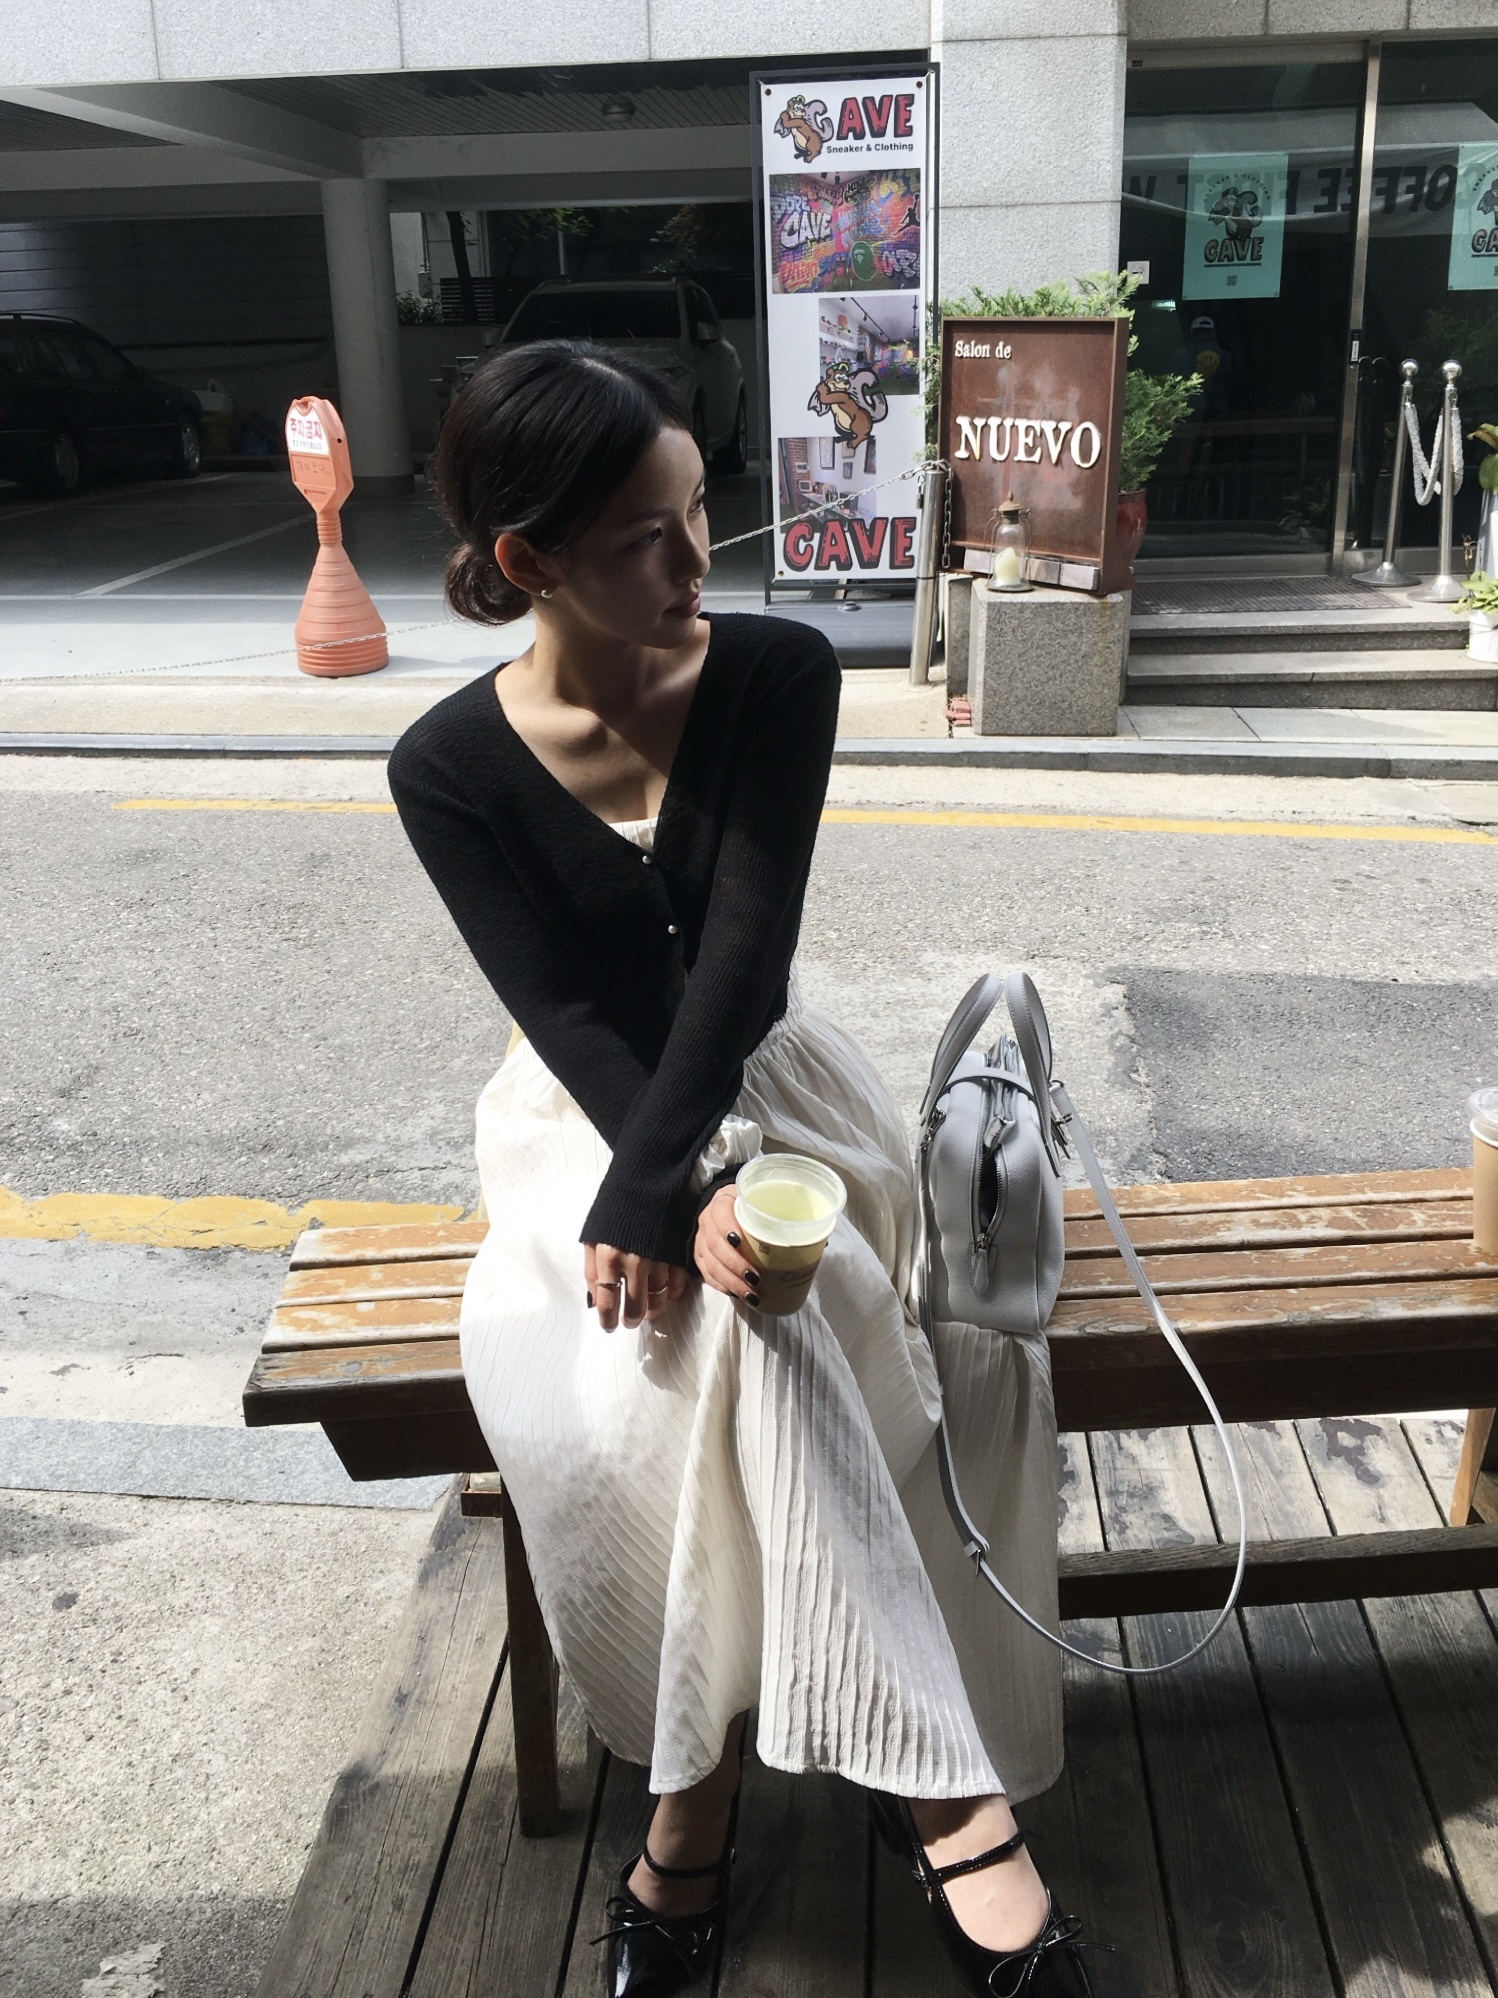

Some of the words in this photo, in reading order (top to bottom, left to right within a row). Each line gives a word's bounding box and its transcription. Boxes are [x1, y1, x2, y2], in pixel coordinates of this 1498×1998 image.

[826, 144, 864, 154] Sneaker
[866, 144, 873, 152] &
[874, 141, 914, 153] Clothing
[780, 210, 832, 249] CAVE
[1204, 236, 1264, 263] CAVE
[954, 340, 990, 358] Salon
[995, 341, 1012, 359] de
[290, 418, 323, 441] 주차금지
[954, 415, 1102, 469] NUEVO
[783, 516, 917, 572] CAVE
